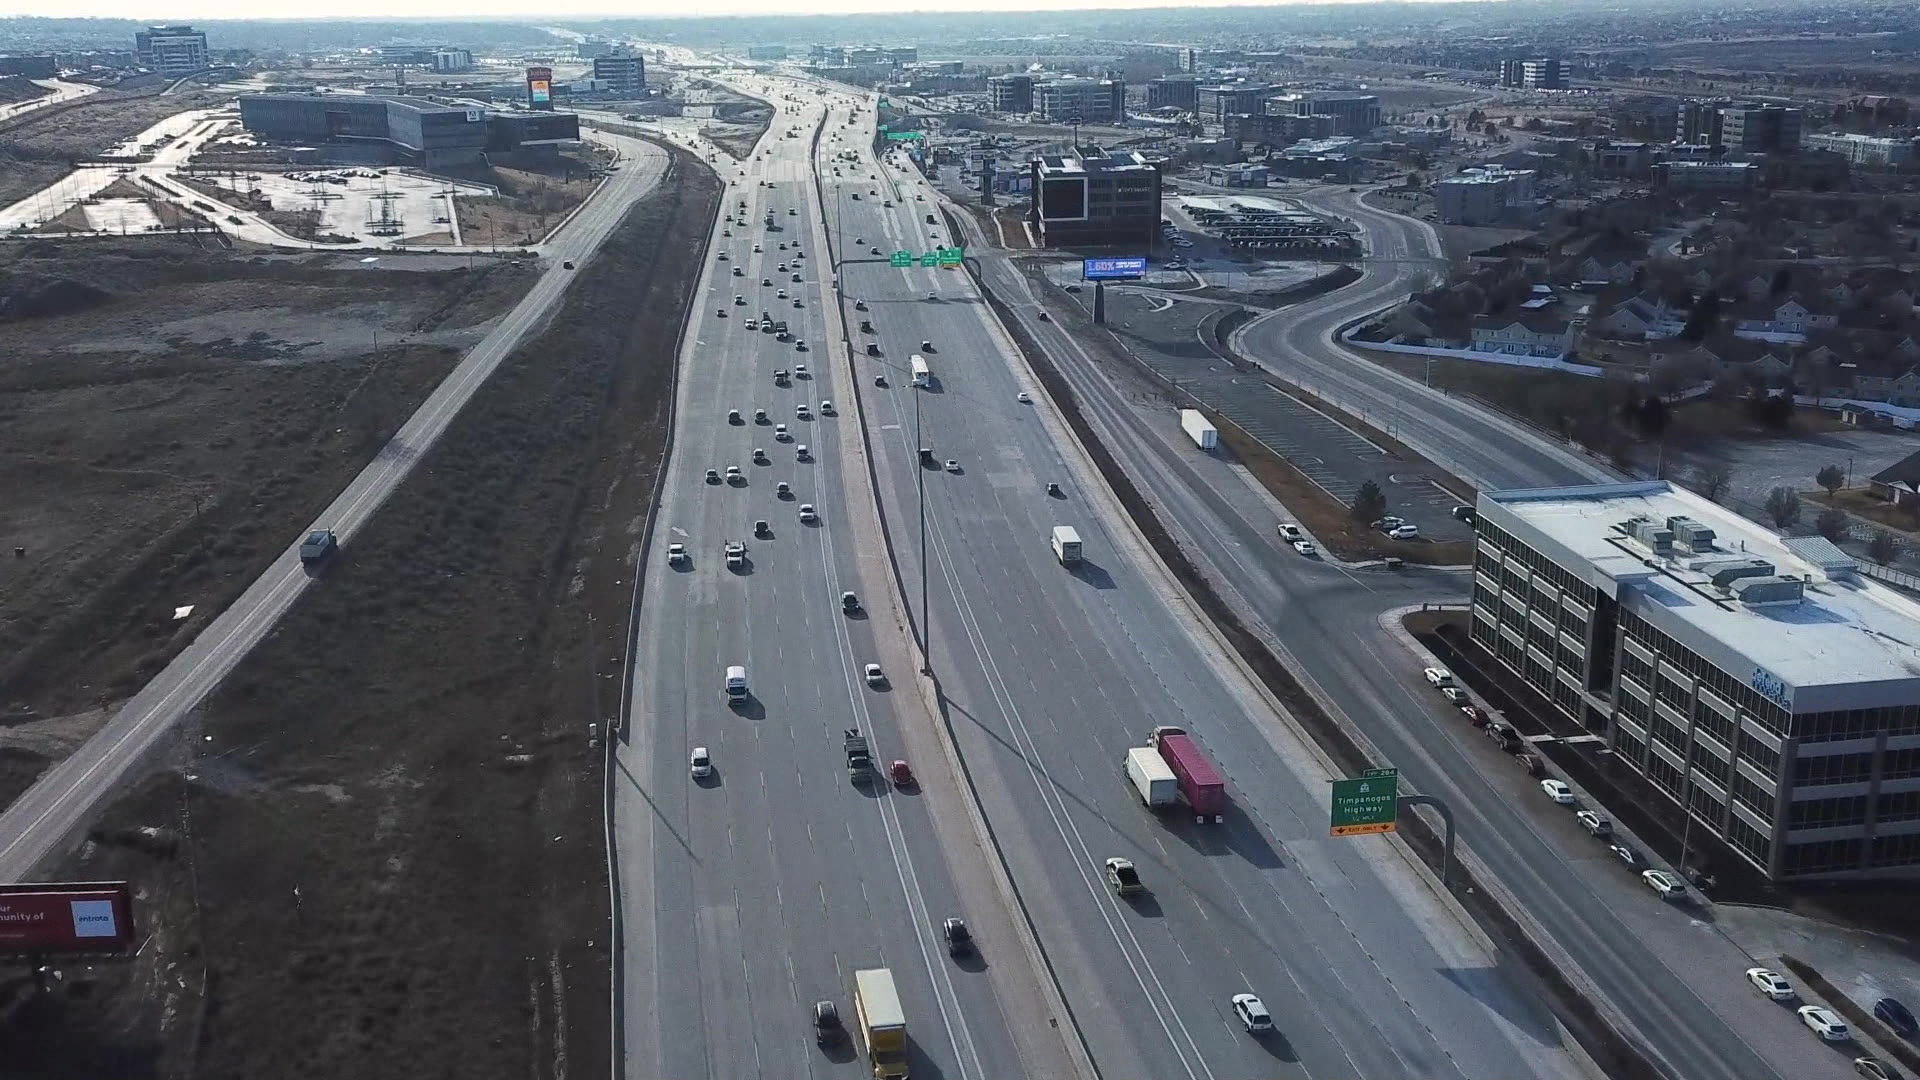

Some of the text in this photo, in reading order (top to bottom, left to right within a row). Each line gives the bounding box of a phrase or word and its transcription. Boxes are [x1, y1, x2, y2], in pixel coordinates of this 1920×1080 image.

[1337, 795, 1391, 805] Timpanogos
[1344, 805, 1383, 814] Highway
[33, 912, 44, 920] of
